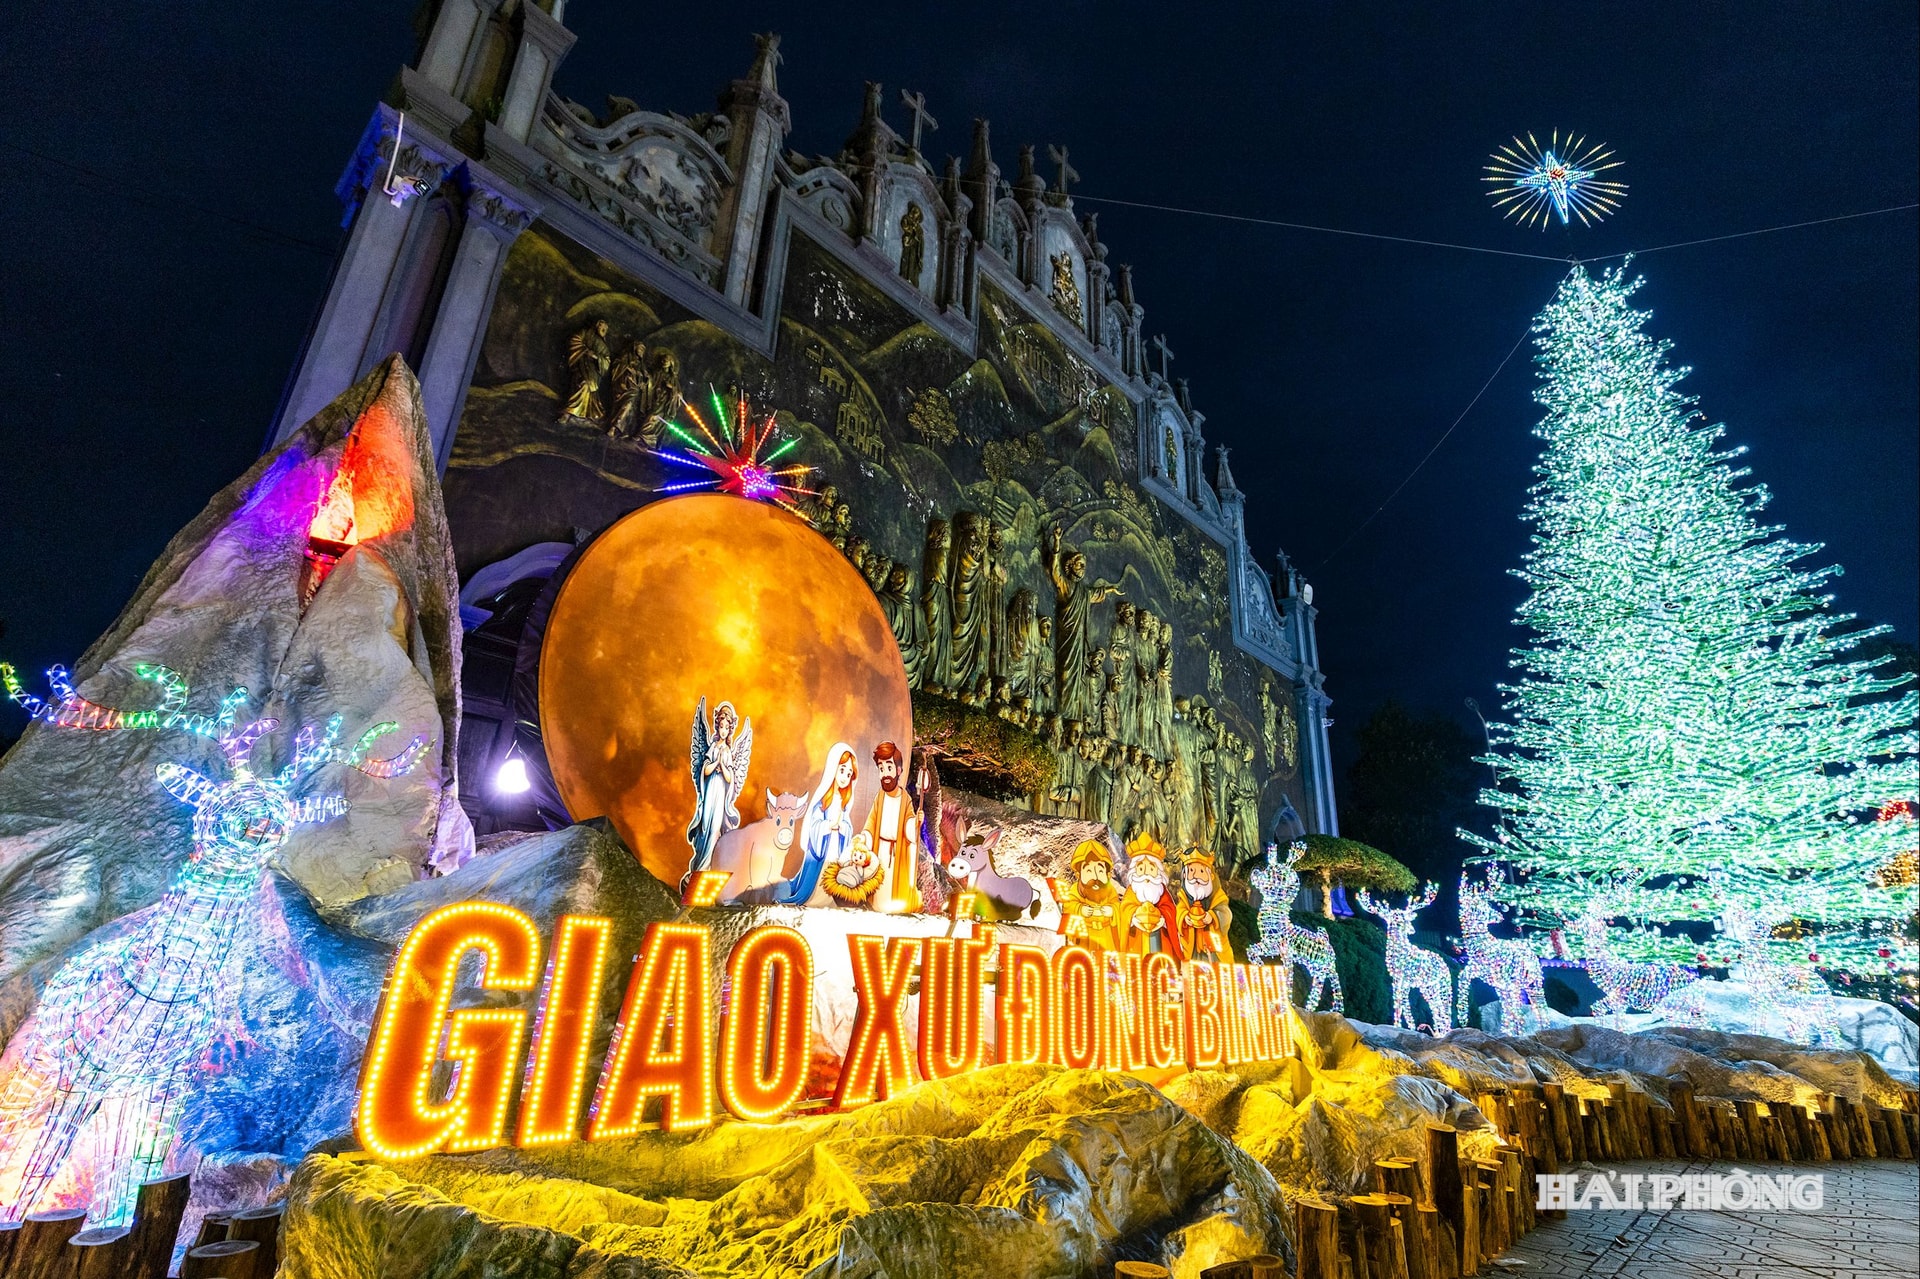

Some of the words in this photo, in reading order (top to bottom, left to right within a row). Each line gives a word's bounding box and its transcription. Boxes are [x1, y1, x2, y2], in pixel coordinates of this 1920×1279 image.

[353, 870, 815, 1162] GIÁO
[832, 891, 998, 1108] XỨ
[995, 876, 1185, 1074] ĐỒNG
[1181, 930, 1297, 1070] BÌNH
